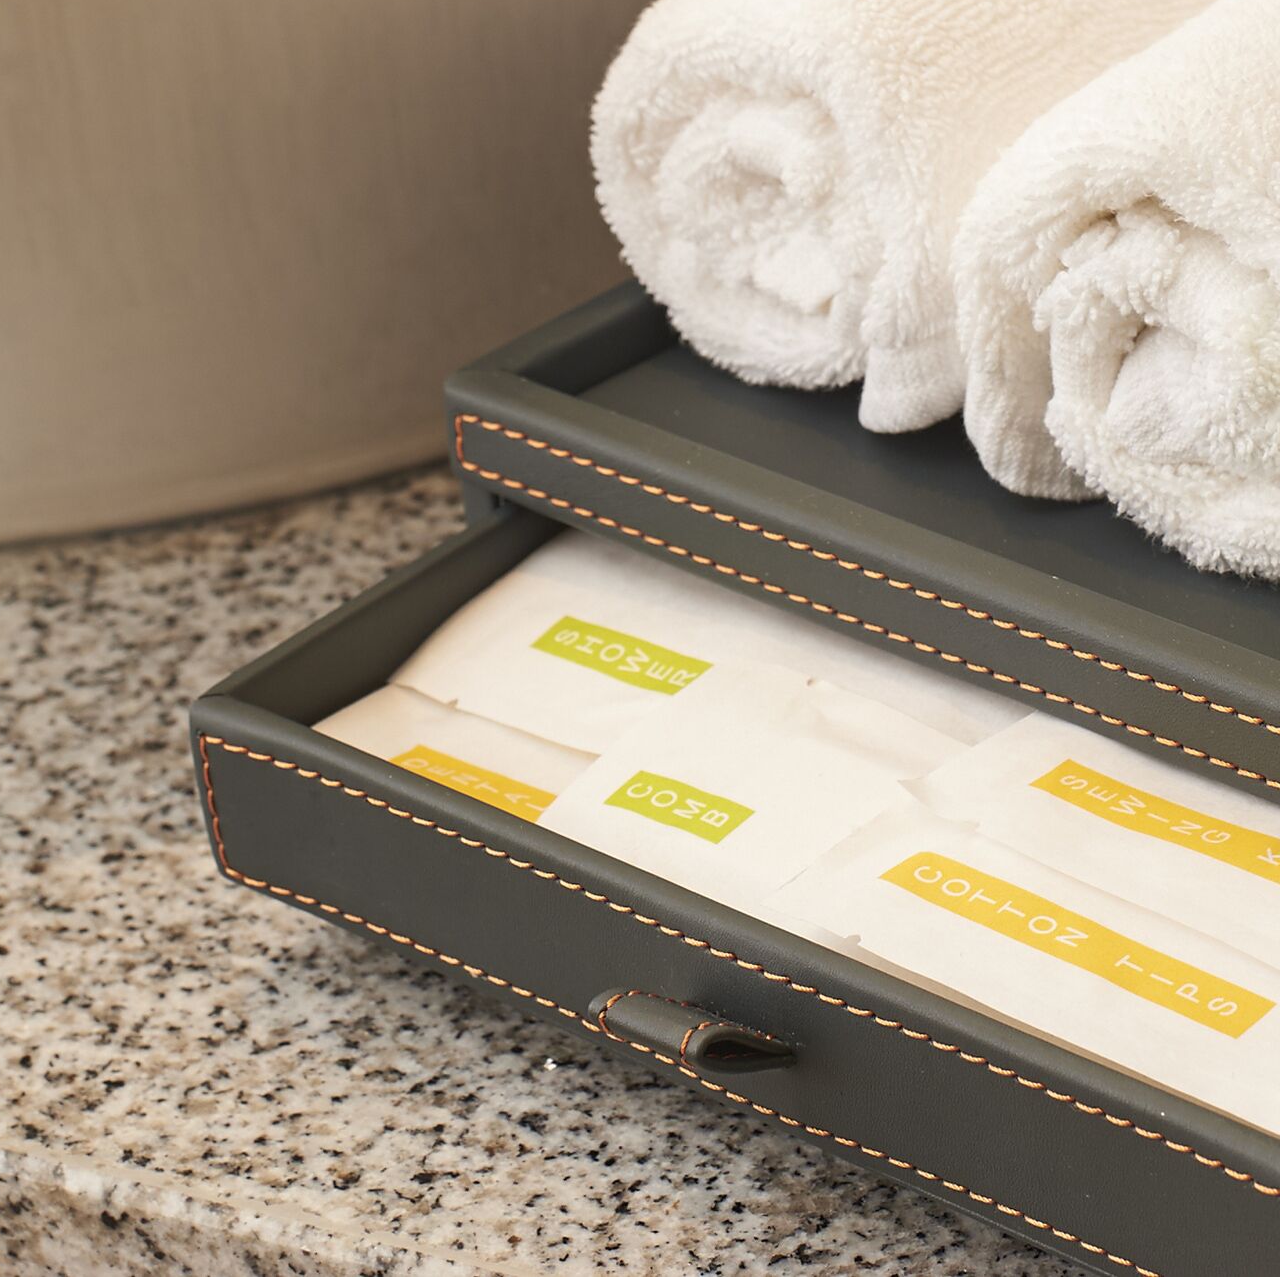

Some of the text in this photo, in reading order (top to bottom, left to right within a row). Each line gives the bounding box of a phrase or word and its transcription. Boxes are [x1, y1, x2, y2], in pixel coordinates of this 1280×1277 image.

[554, 627, 697, 688] SHOWER
[625, 781, 730, 828] COMB
[1059, 773, 1231, 844] SEWING
[913, 864, 1238, 1016] COTTON TIPS
